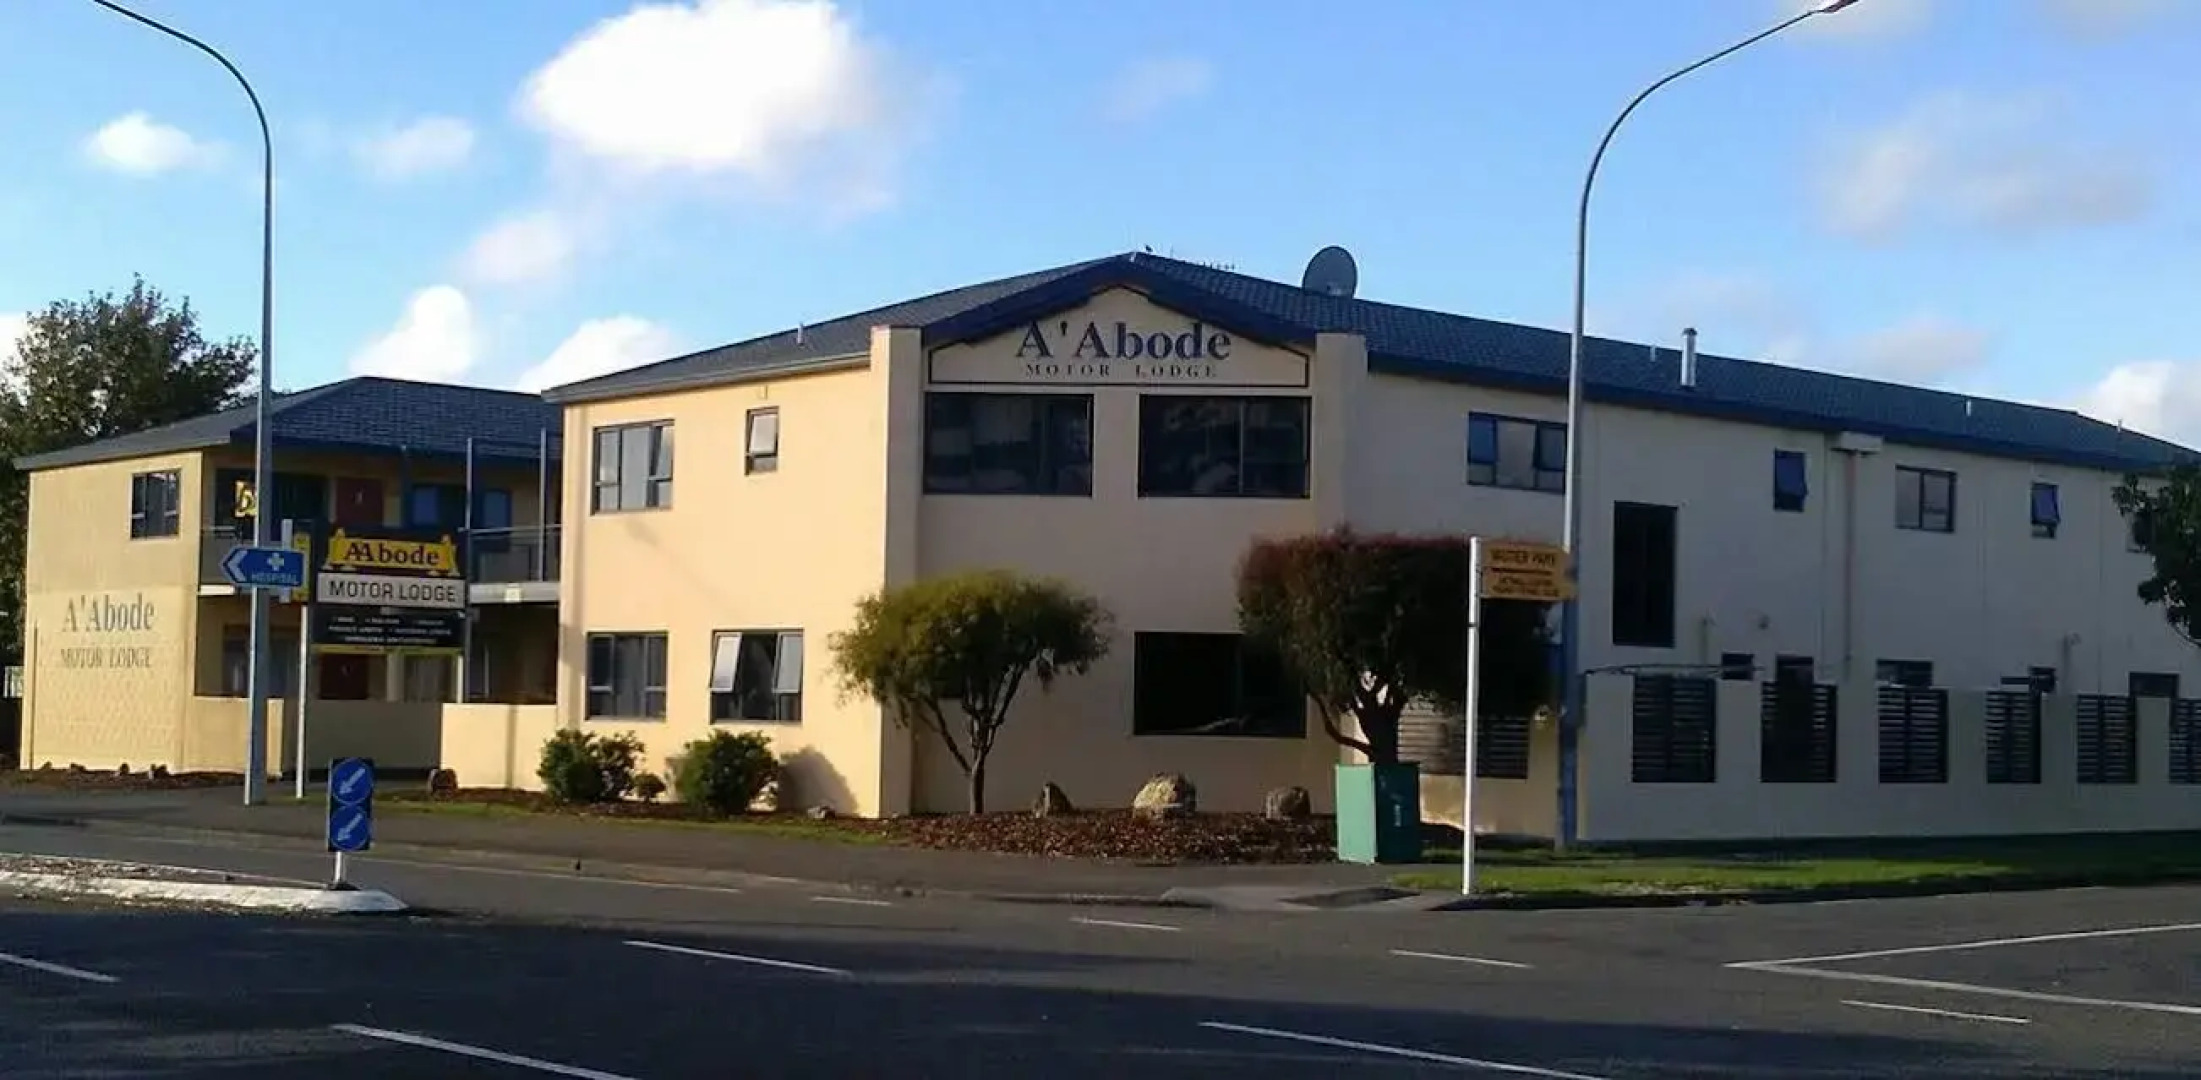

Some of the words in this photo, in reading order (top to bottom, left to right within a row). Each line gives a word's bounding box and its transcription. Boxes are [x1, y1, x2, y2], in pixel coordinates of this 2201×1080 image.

[1015, 320, 1232, 361] A'Abode
[1026, 363, 1111, 377] MOTOR
[1135, 363, 1217, 377] LODGE
[329, 580, 393, 599] MOTOR
[399, 584, 456, 602] LODGE
[61, 592, 155, 632] A'Abode
